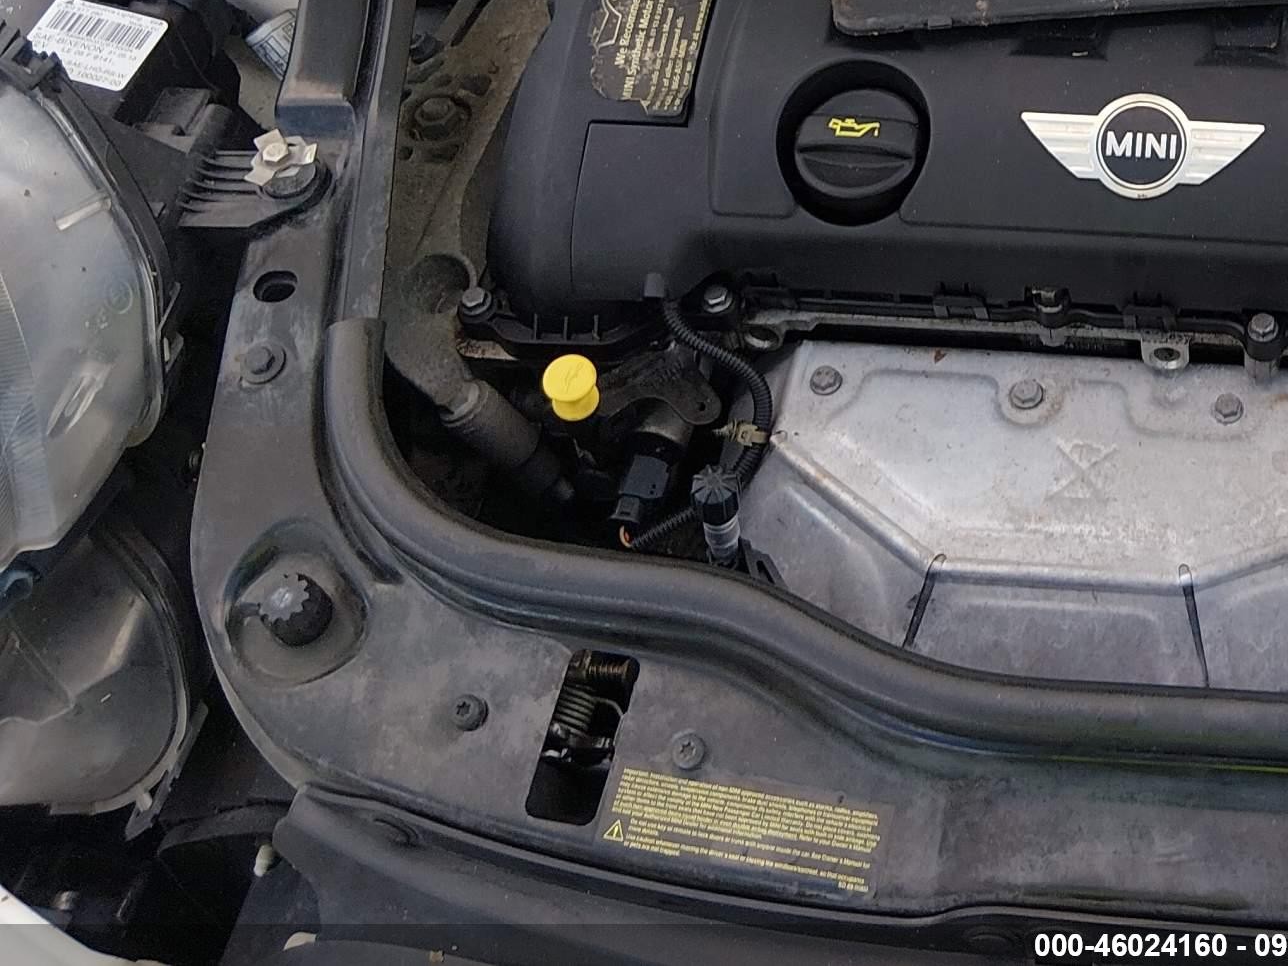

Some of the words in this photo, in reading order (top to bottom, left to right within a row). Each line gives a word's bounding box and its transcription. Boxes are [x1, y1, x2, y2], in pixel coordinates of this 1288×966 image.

[614, 45, 628, 67] We
[627, 28, 649, 75] Synthetic
[1105, 131, 1178, 160] MINI
